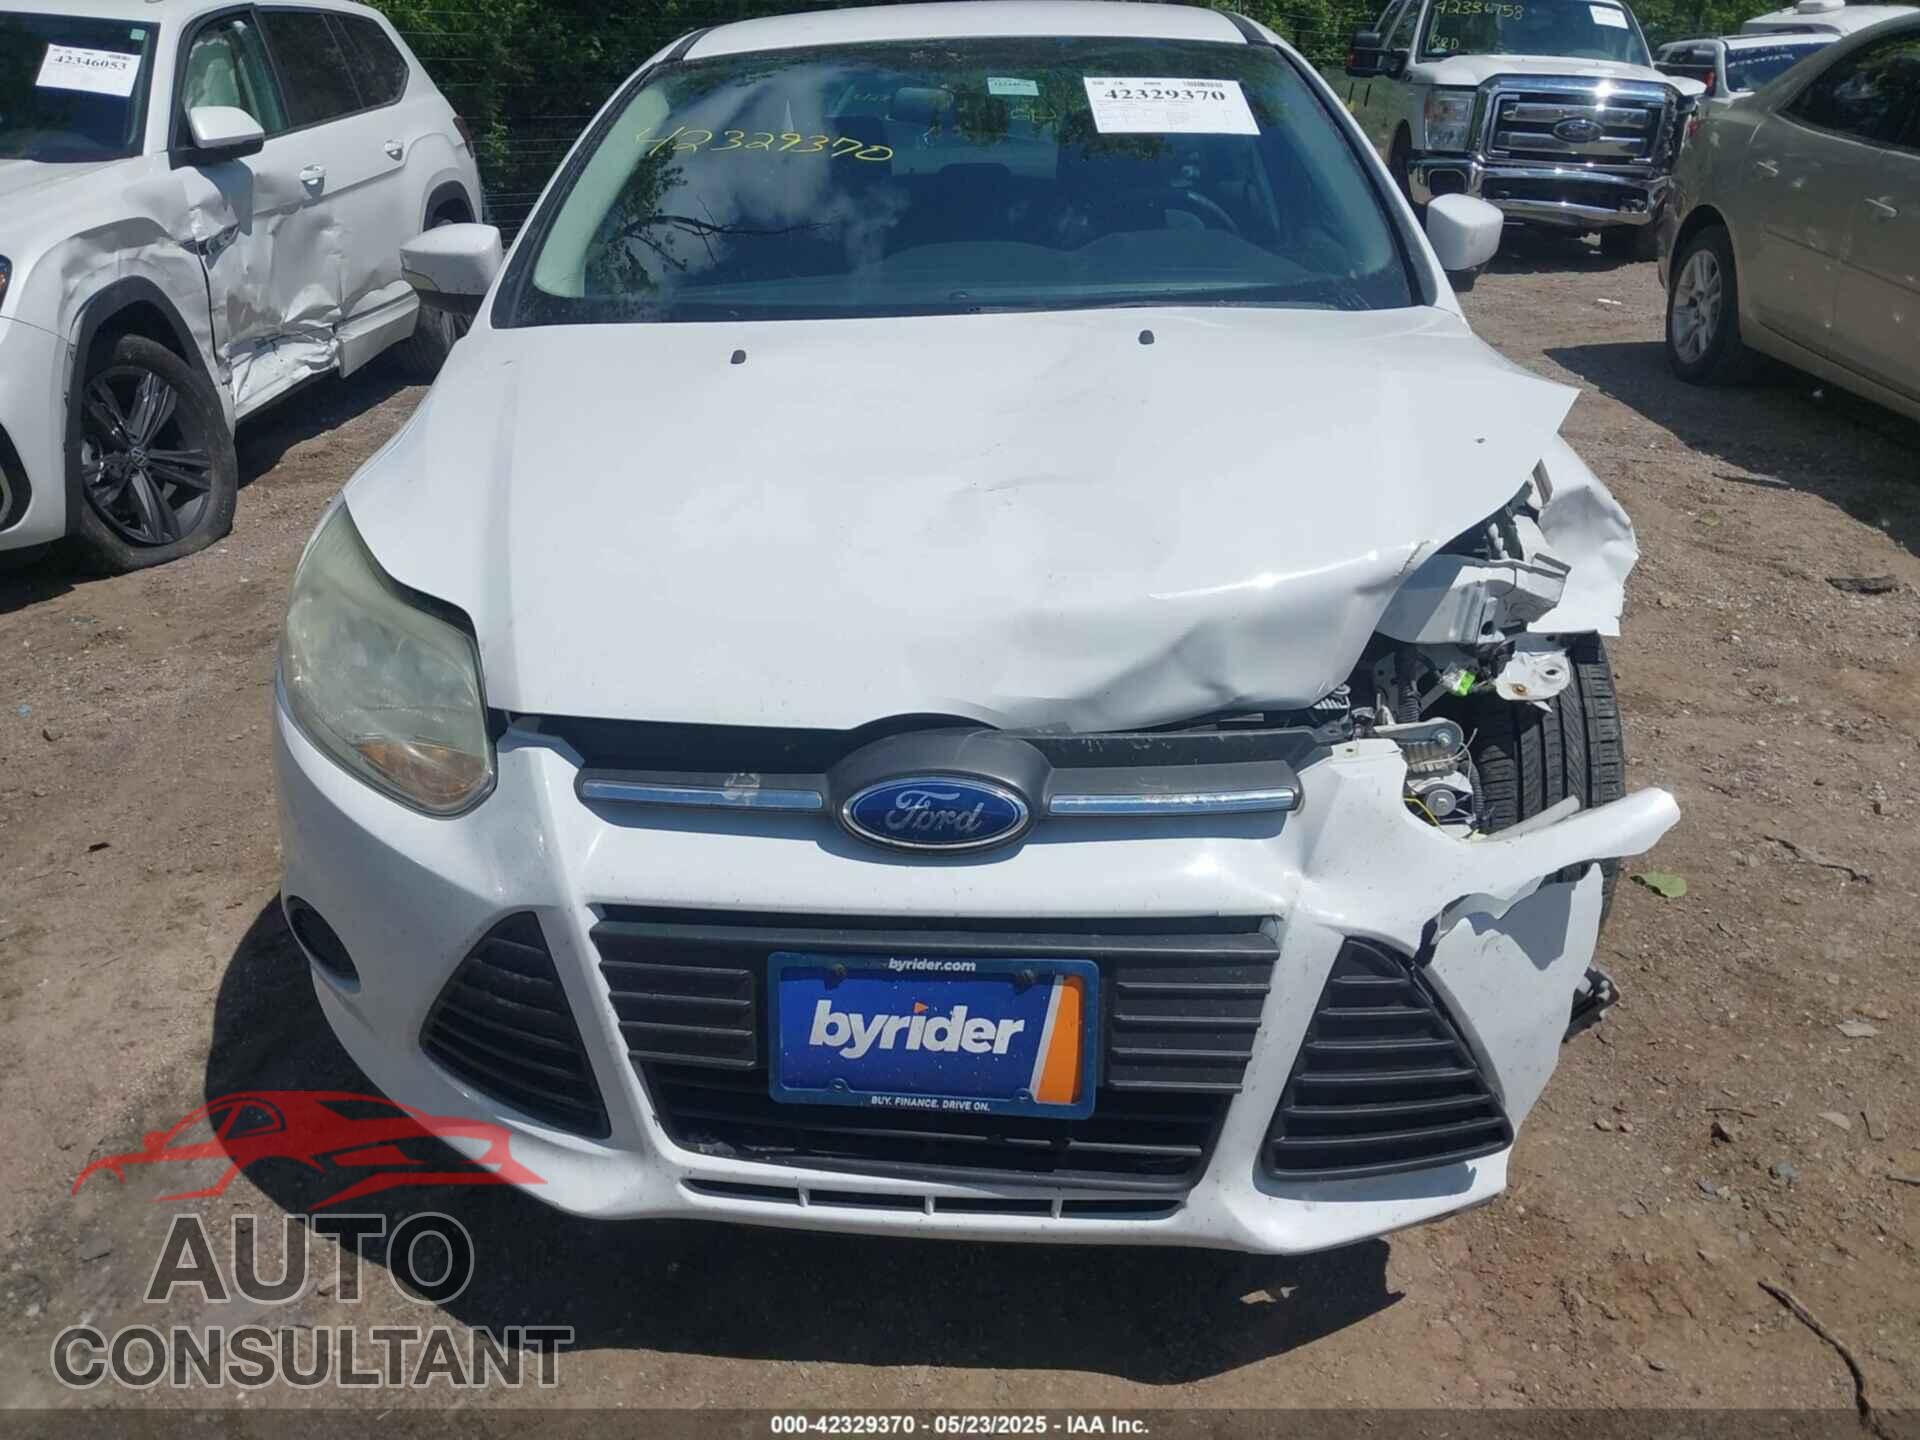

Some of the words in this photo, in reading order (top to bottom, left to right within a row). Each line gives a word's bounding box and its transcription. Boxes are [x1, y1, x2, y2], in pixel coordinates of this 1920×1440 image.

[1104, 88, 1226, 101] 42329370
[635, 126, 893, 161] 42329370
[885, 790, 985, 831] Ford
[888, 957, 976, 972] byrider.com
[809, 999, 1025, 1059] byrider
[871, 1096, 892, 1106] BUY.
[895, 1097, 939, 1109] FINANCE.
[942, 1100, 971, 1110] DRIVE
[973, 1101, 991, 1112] ON.
